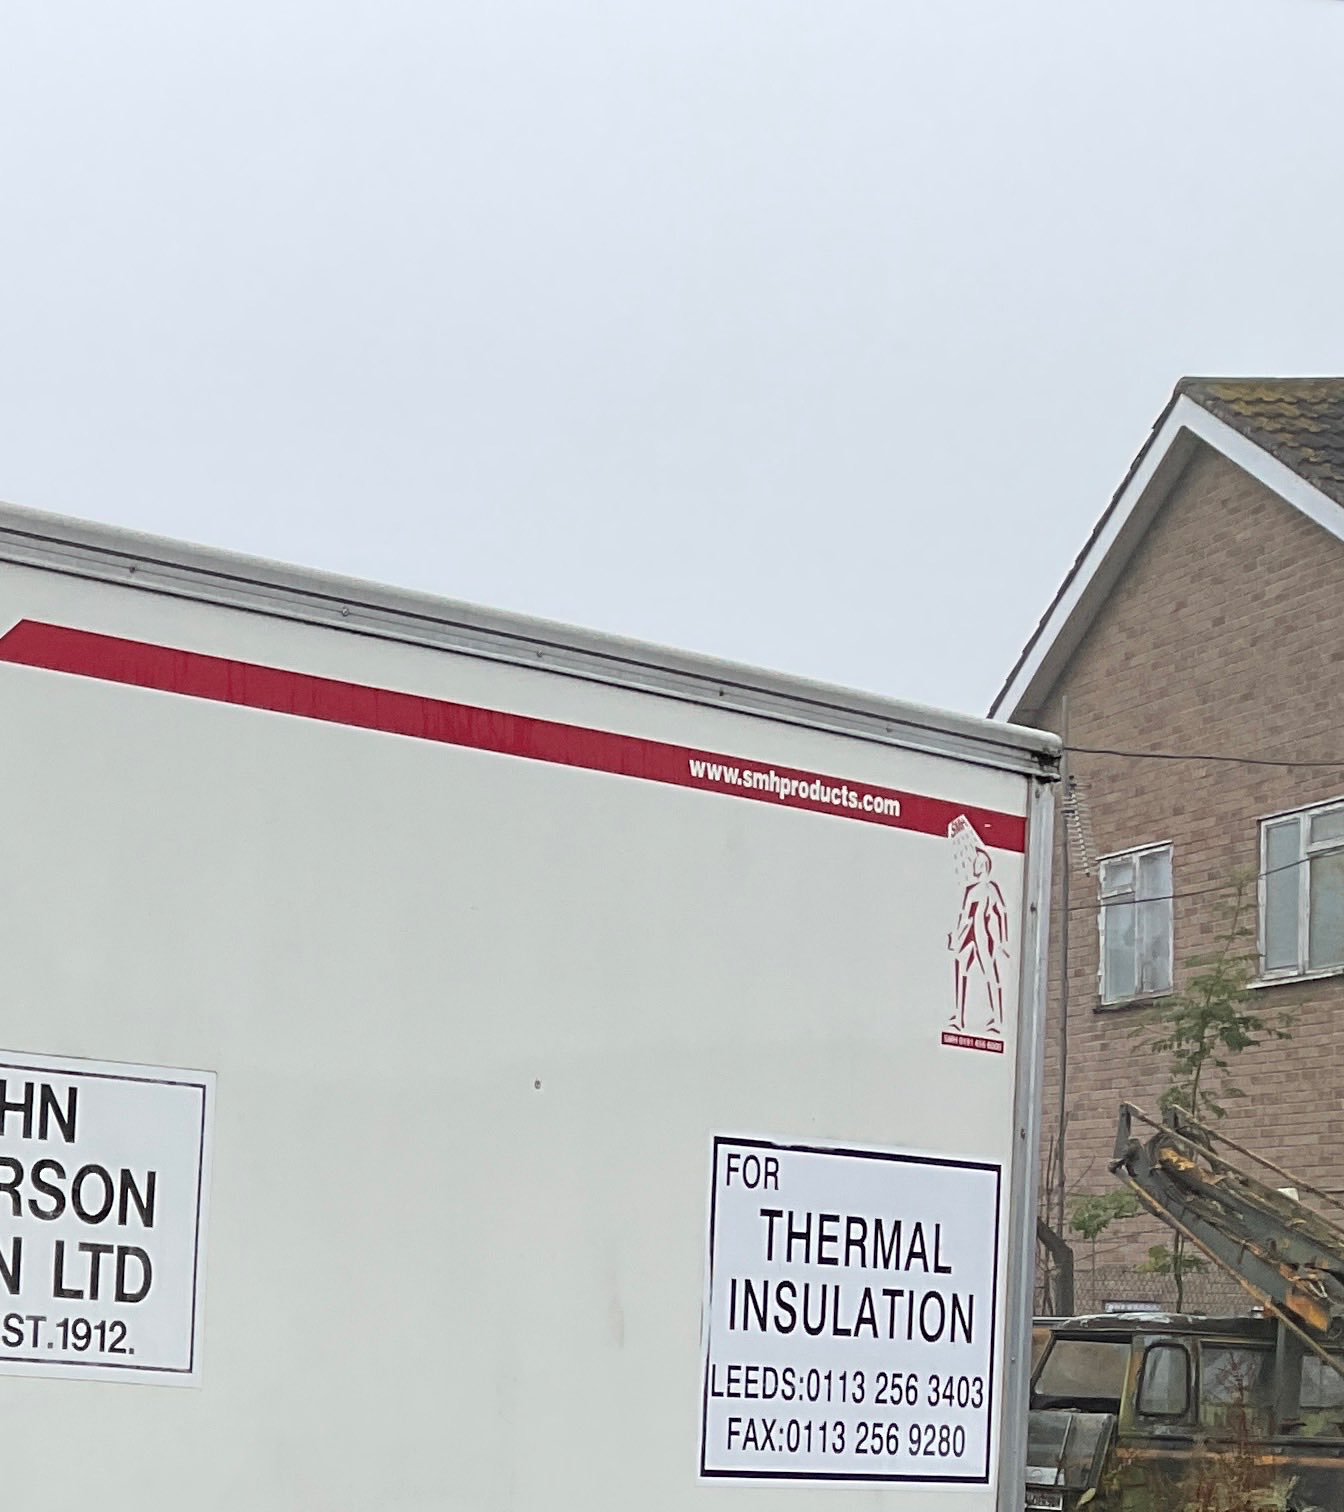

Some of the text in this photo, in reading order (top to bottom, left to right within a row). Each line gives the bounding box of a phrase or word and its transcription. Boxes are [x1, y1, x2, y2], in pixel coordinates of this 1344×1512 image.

[689, 759, 901, 816] www.smhproducts.com
[725, 1153, 780, 1190] FOR
[760, 1208, 952, 1275] THERMAL
[53, 1239, 153, 1304] LTD
[729, 1278, 974, 1344] INSULATION
[875, 1372, 918, 1406] 256
[927, 1374, 984, 1408] 3403
[855, 1421, 899, 1456] 256
[908, 1423, 966, 1457] 9280
